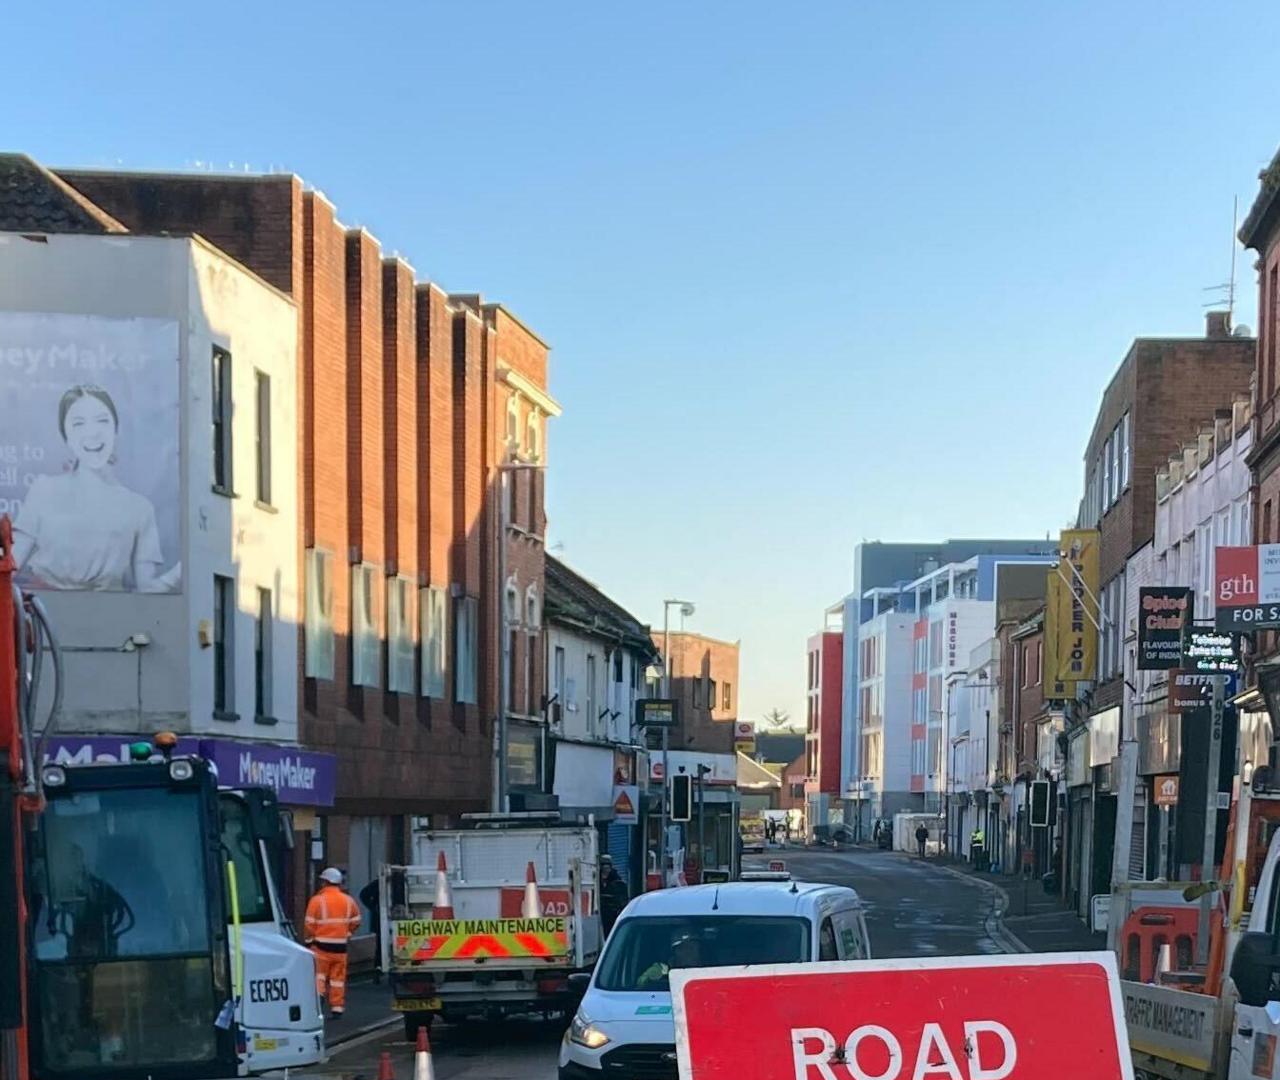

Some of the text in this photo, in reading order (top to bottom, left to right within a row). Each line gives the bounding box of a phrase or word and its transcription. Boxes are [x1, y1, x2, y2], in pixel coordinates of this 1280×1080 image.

[23, 442, 45, 462] to
[1220, 573, 1255, 600] gth
[1145, 614, 1184, 631] Club
[1233, 608, 1264, 622] FOR
[1145, 651, 1157, 660] OF
[1175, 674, 1232, 686] BETFRD
[238, 751, 318, 792] MoneyMaker
[397, 917, 565, 937] HIGHWAY MAINTENANCE
[249, 977, 289, 1003] ECR50
[1125, 994, 1205, 1042] TRAFFIC MANAGEMENT
